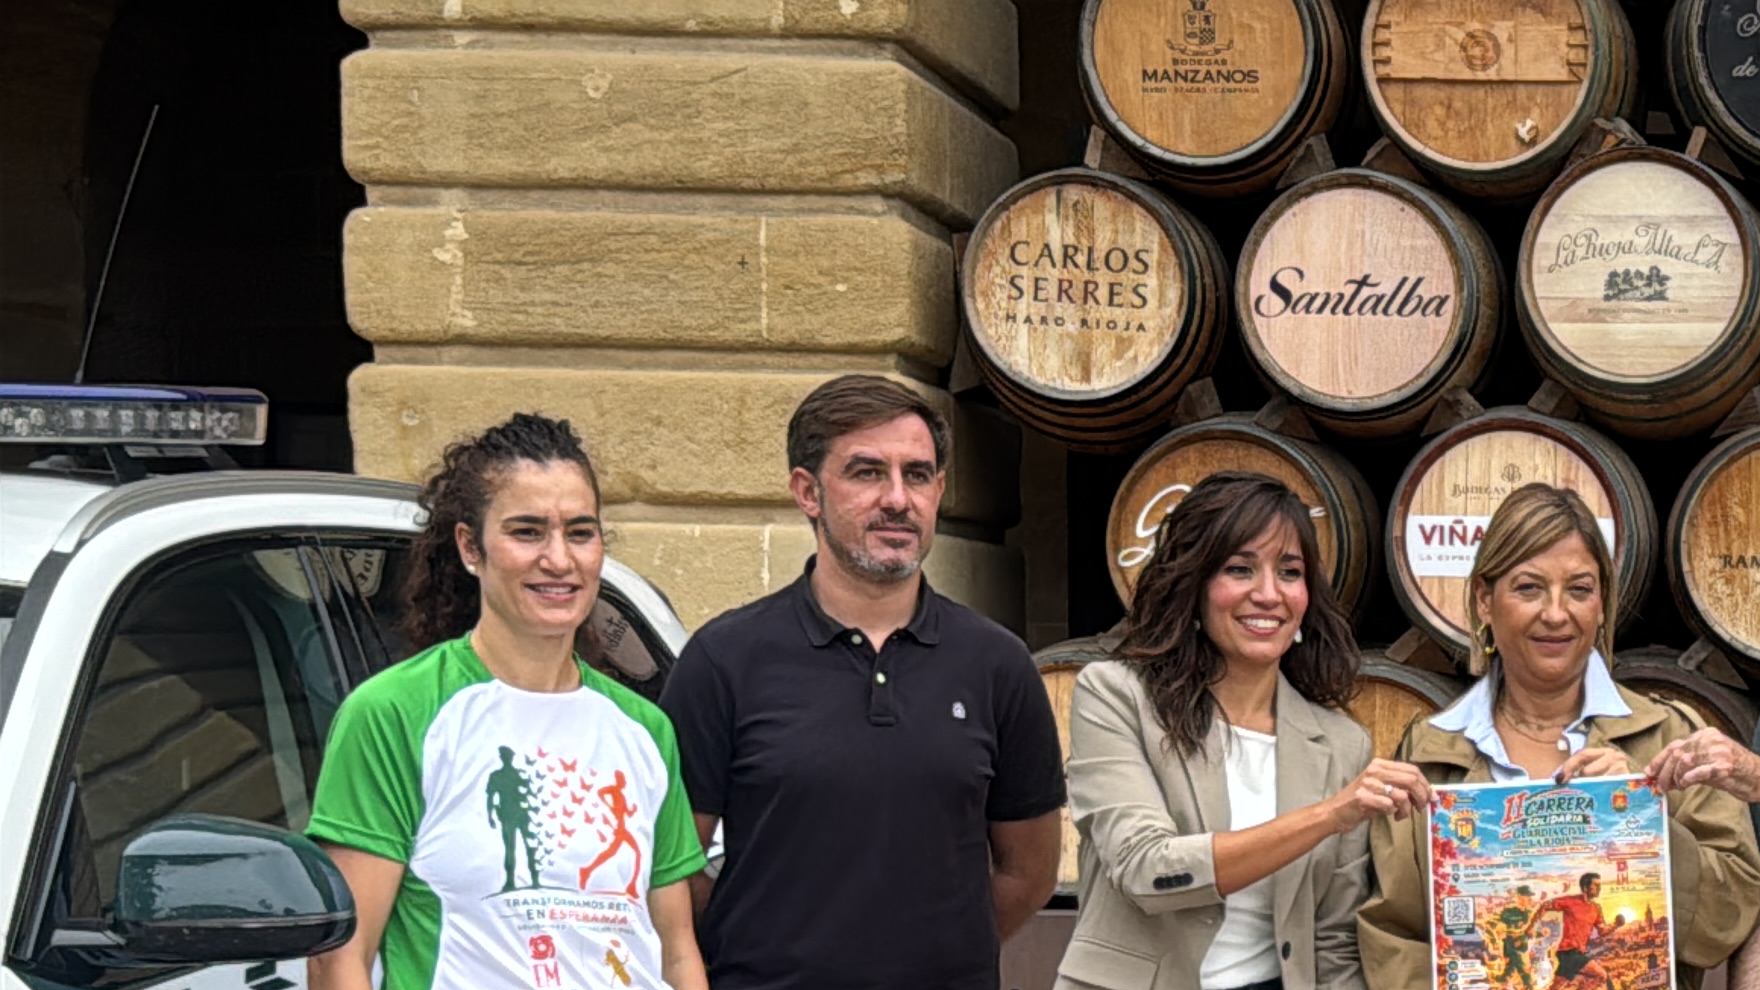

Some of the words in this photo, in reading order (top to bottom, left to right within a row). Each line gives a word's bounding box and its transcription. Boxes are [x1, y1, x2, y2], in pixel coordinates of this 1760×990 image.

[1172, 57, 1228, 66] BODEGAS
[1732, 56, 1759, 77] de
[1142, 69, 1260, 84] MANZANOS
[1009, 240, 1150, 275] CARLOS
[1547, 233, 1576, 273] La
[1573, 227, 1634, 263] Rioja
[1634, 222, 1682, 261] Alta
[1007, 274, 1150, 309] SERRES
[1254, 266, 1450, 318] Santalba
[1005, 312, 1066, 327] HARO
[1080, 318, 1147, 332] RIOJA
[1418, 518, 1485, 546] VIÑA
[1524, 796, 1595, 816] CARRERA
[526, 909, 545, 921] EN
